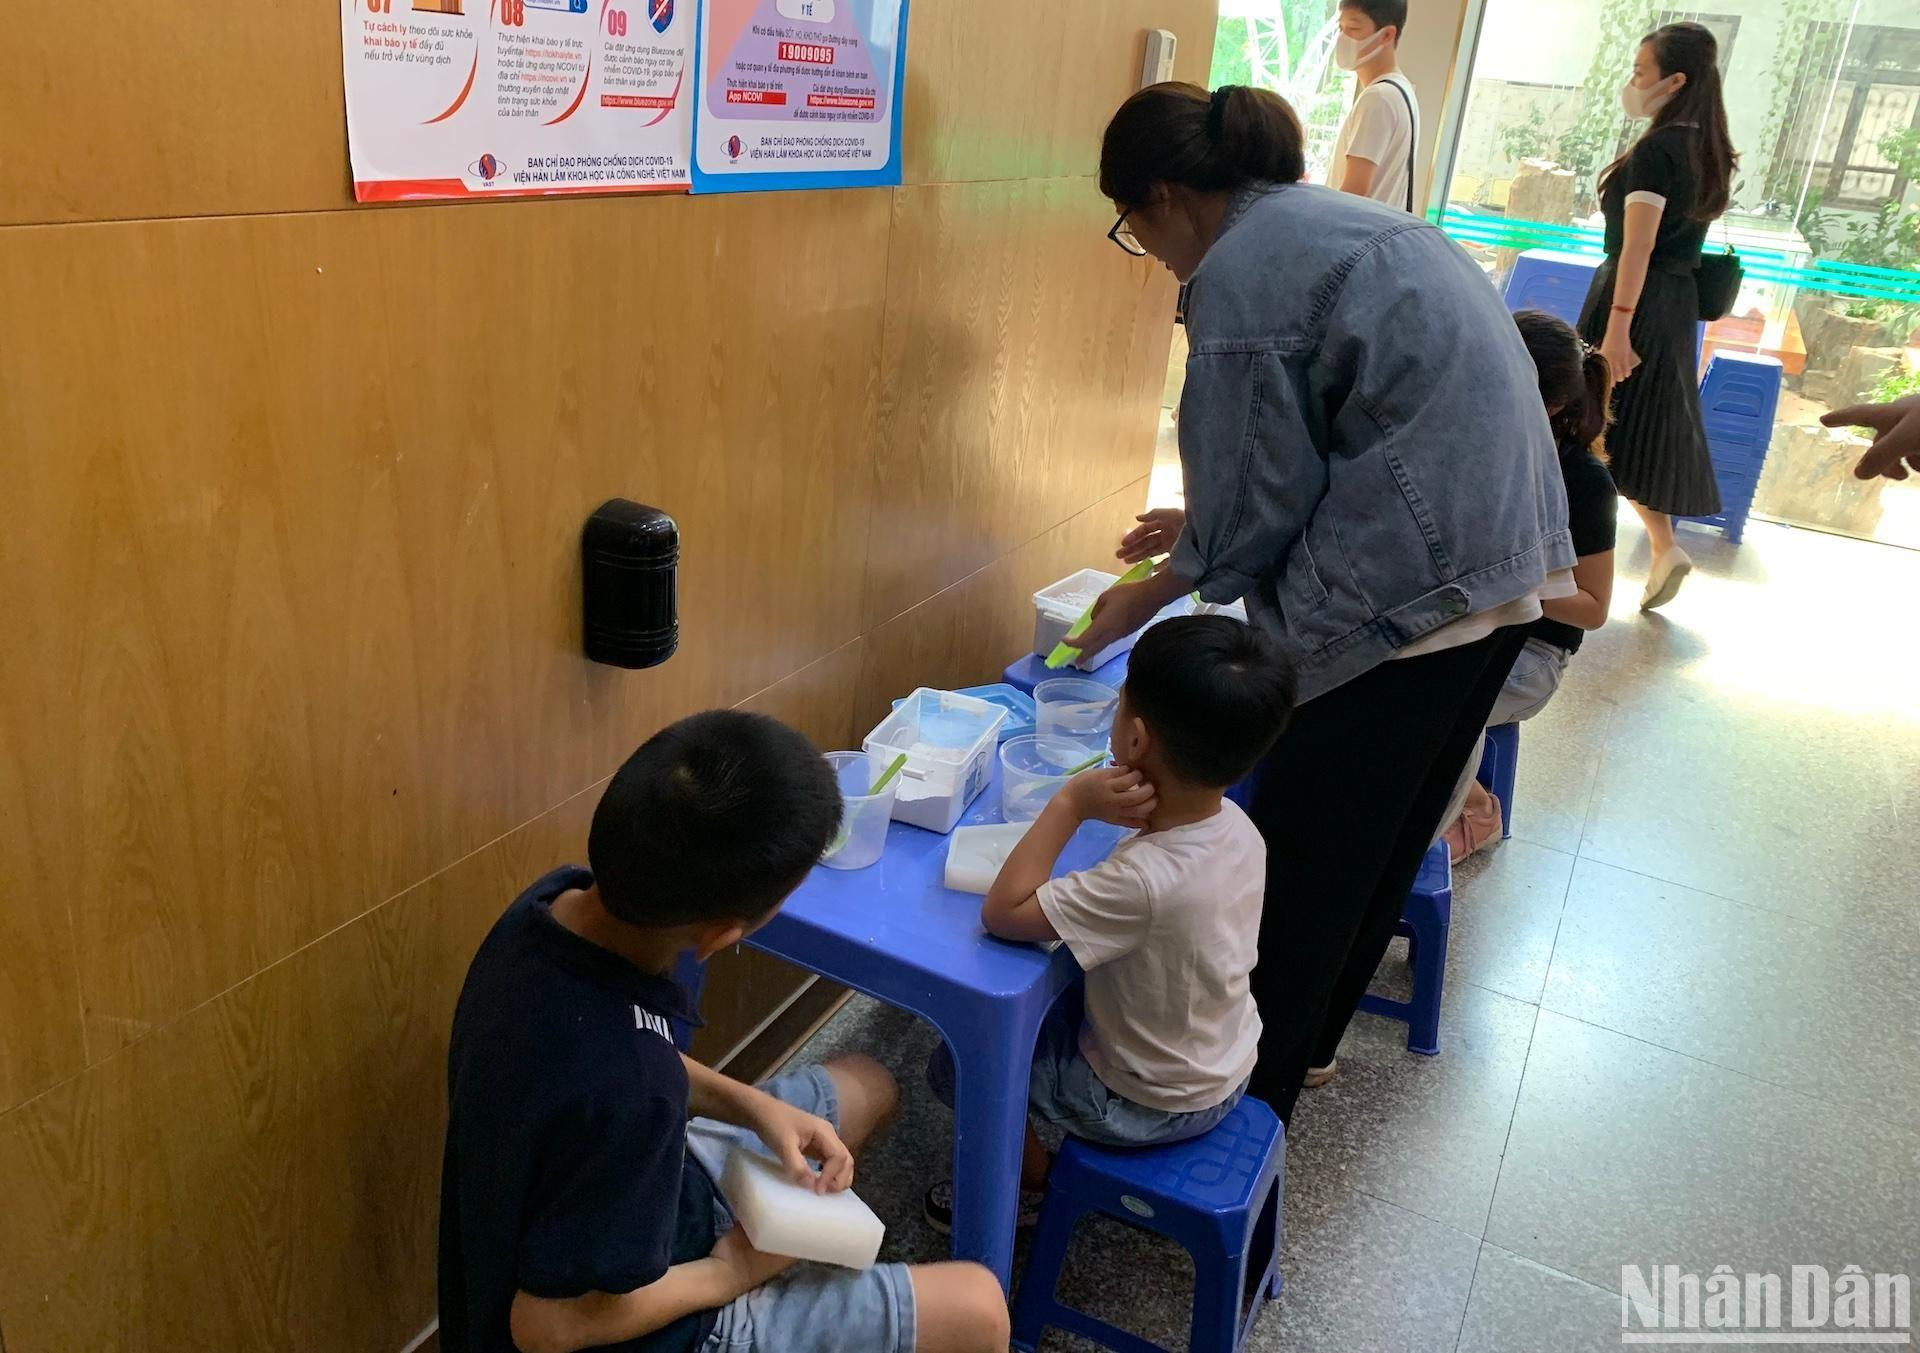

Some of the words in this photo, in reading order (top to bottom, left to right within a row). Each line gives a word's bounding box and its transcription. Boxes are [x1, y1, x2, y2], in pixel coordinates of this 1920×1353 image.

[501, 0, 524, 27] 08
[363, 20, 375, 32] Tự
[377, 22, 397, 32] cách
[409, 26, 426, 35] theo
[441, 28, 454, 37] sức
[455, 28, 473, 38] khỏe
[608, 9, 627, 37] 09
[364, 36, 382, 46] khai
[384, 37, 400, 47] báo
[409, 38, 418, 48] tế
[434, 40, 444, 50] đủ
[498, 32, 514, 42] Thực
[516, 34, 530, 44] hiện
[532, 36, 545, 45] khai
[364, 49, 380, 60] nếu
[382, 50, 393, 61] trở
[406, 51, 415, 62] từ
[416, 54, 434, 66] vùng
[436, 56, 451, 66] dịch
[651, 46, 675, 56] Bluezone
[782, 44, 832, 62] 19009095
[498, 58, 514, 68] hoặc
[556, 62, 578, 72] NCOVI
[645, 59, 657, 67] nguy
[498, 71, 508, 81] địa
[728, 92, 742, 102] App
[742, 92, 763, 102] NCOVI
[498, 108, 510, 117] của
[761, 137, 773, 146] BAN
[814, 135, 832, 146] CHỐNG
[844, 138, 865, 146] COVID-19
[750, 147, 763, 159] VIỆN
[788, 149, 802, 158] KHOA
[862, 150, 872, 158] NAM
[528, 157, 544, 168] BAN
[546, 154, 558, 168] CHỈ
[560, 157, 575, 169] ĐẠO
[577, 154, 602, 167] PHÒNG
[603, 153, 627, 166] CHỐNG
[629, 156, 644, 167] DỊCH
[645, 156, 673, 166] COVID-19
[513, 170, 531, 185] VIỆN
[532, 169, 549, 182] HÀN
[551, 169, 566, 182] LÂM
[568, 171, 588, 181] KHOA
[590, 171, 604, 182] HỌC
[606, 168, 616, 180] VÀ
[616, 168, 636, 180] CÔNG
[636, 168, 655, 181] NGHỆ
[656, 168, 670, 179] VIỆT
[672, 169, 686, 178] NAM
